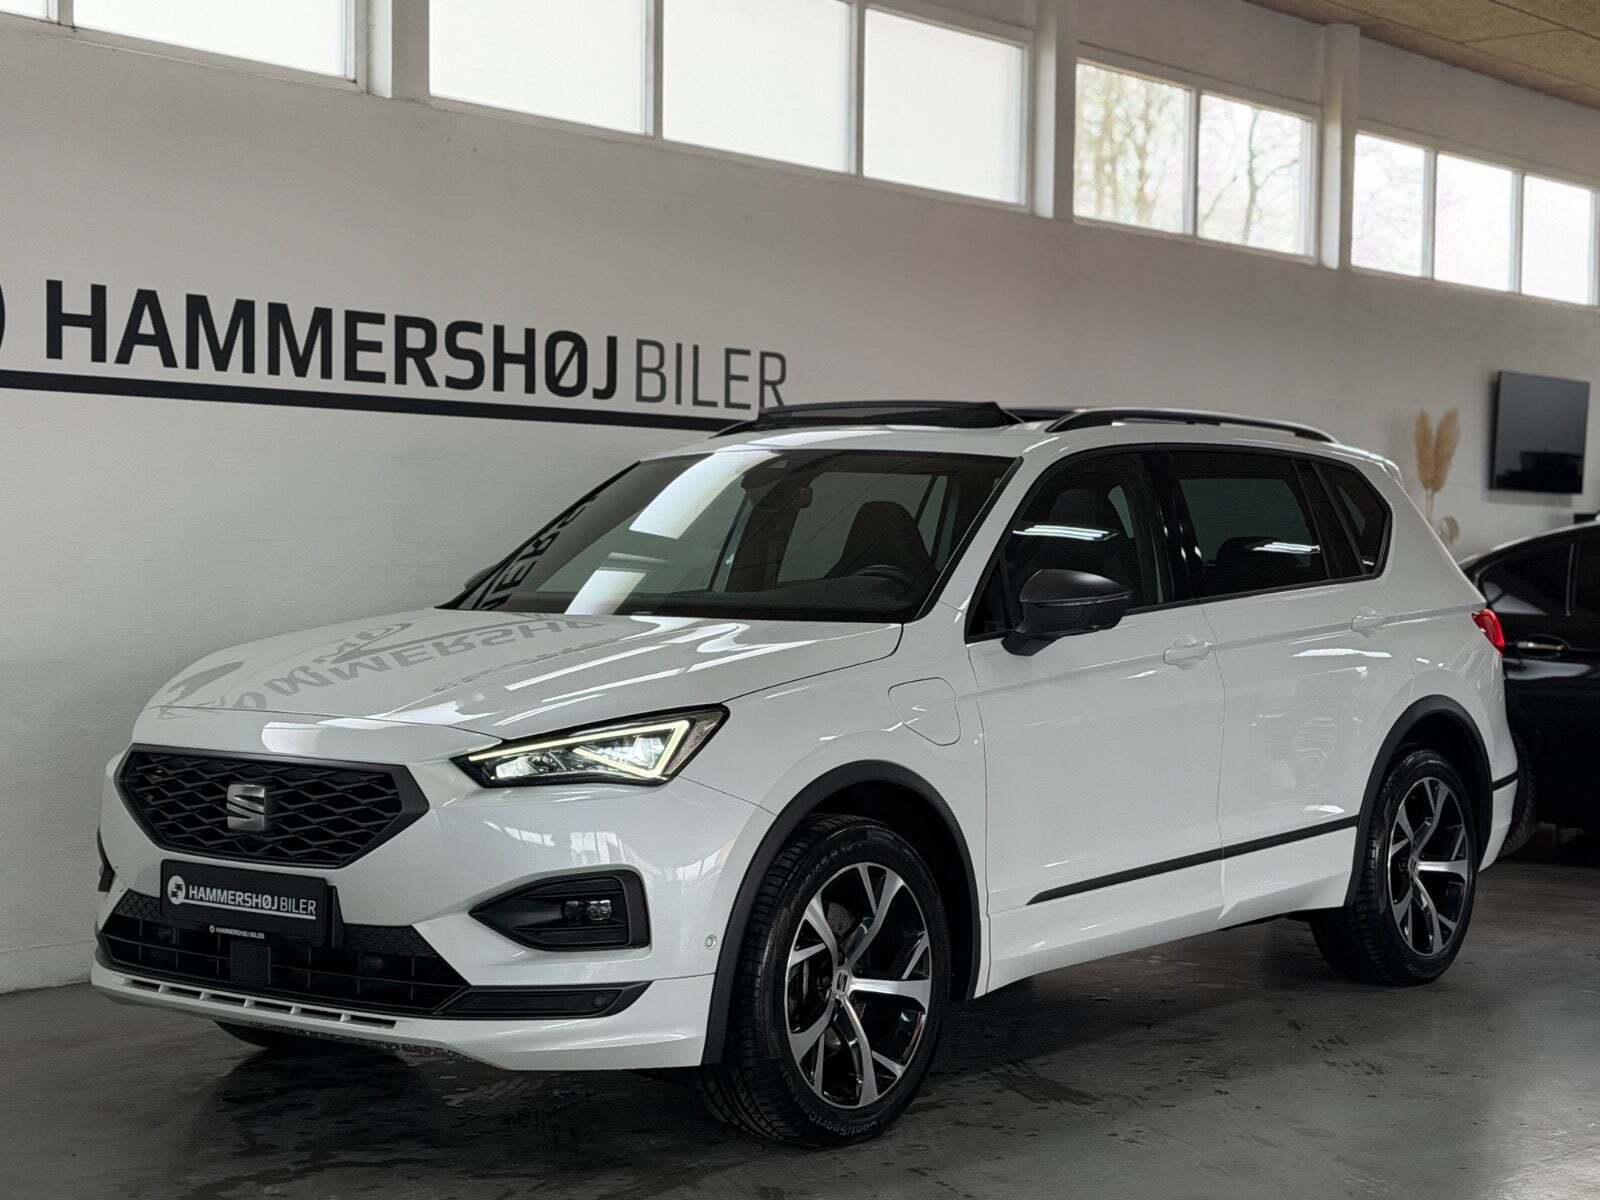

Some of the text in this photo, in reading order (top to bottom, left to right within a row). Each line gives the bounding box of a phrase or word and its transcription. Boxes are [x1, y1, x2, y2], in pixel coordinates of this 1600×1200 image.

[46, 279, 788, 408] HAMMERSHØJ BILER
[188, 885, 316, 915] HAMMERSHØJ BILER
